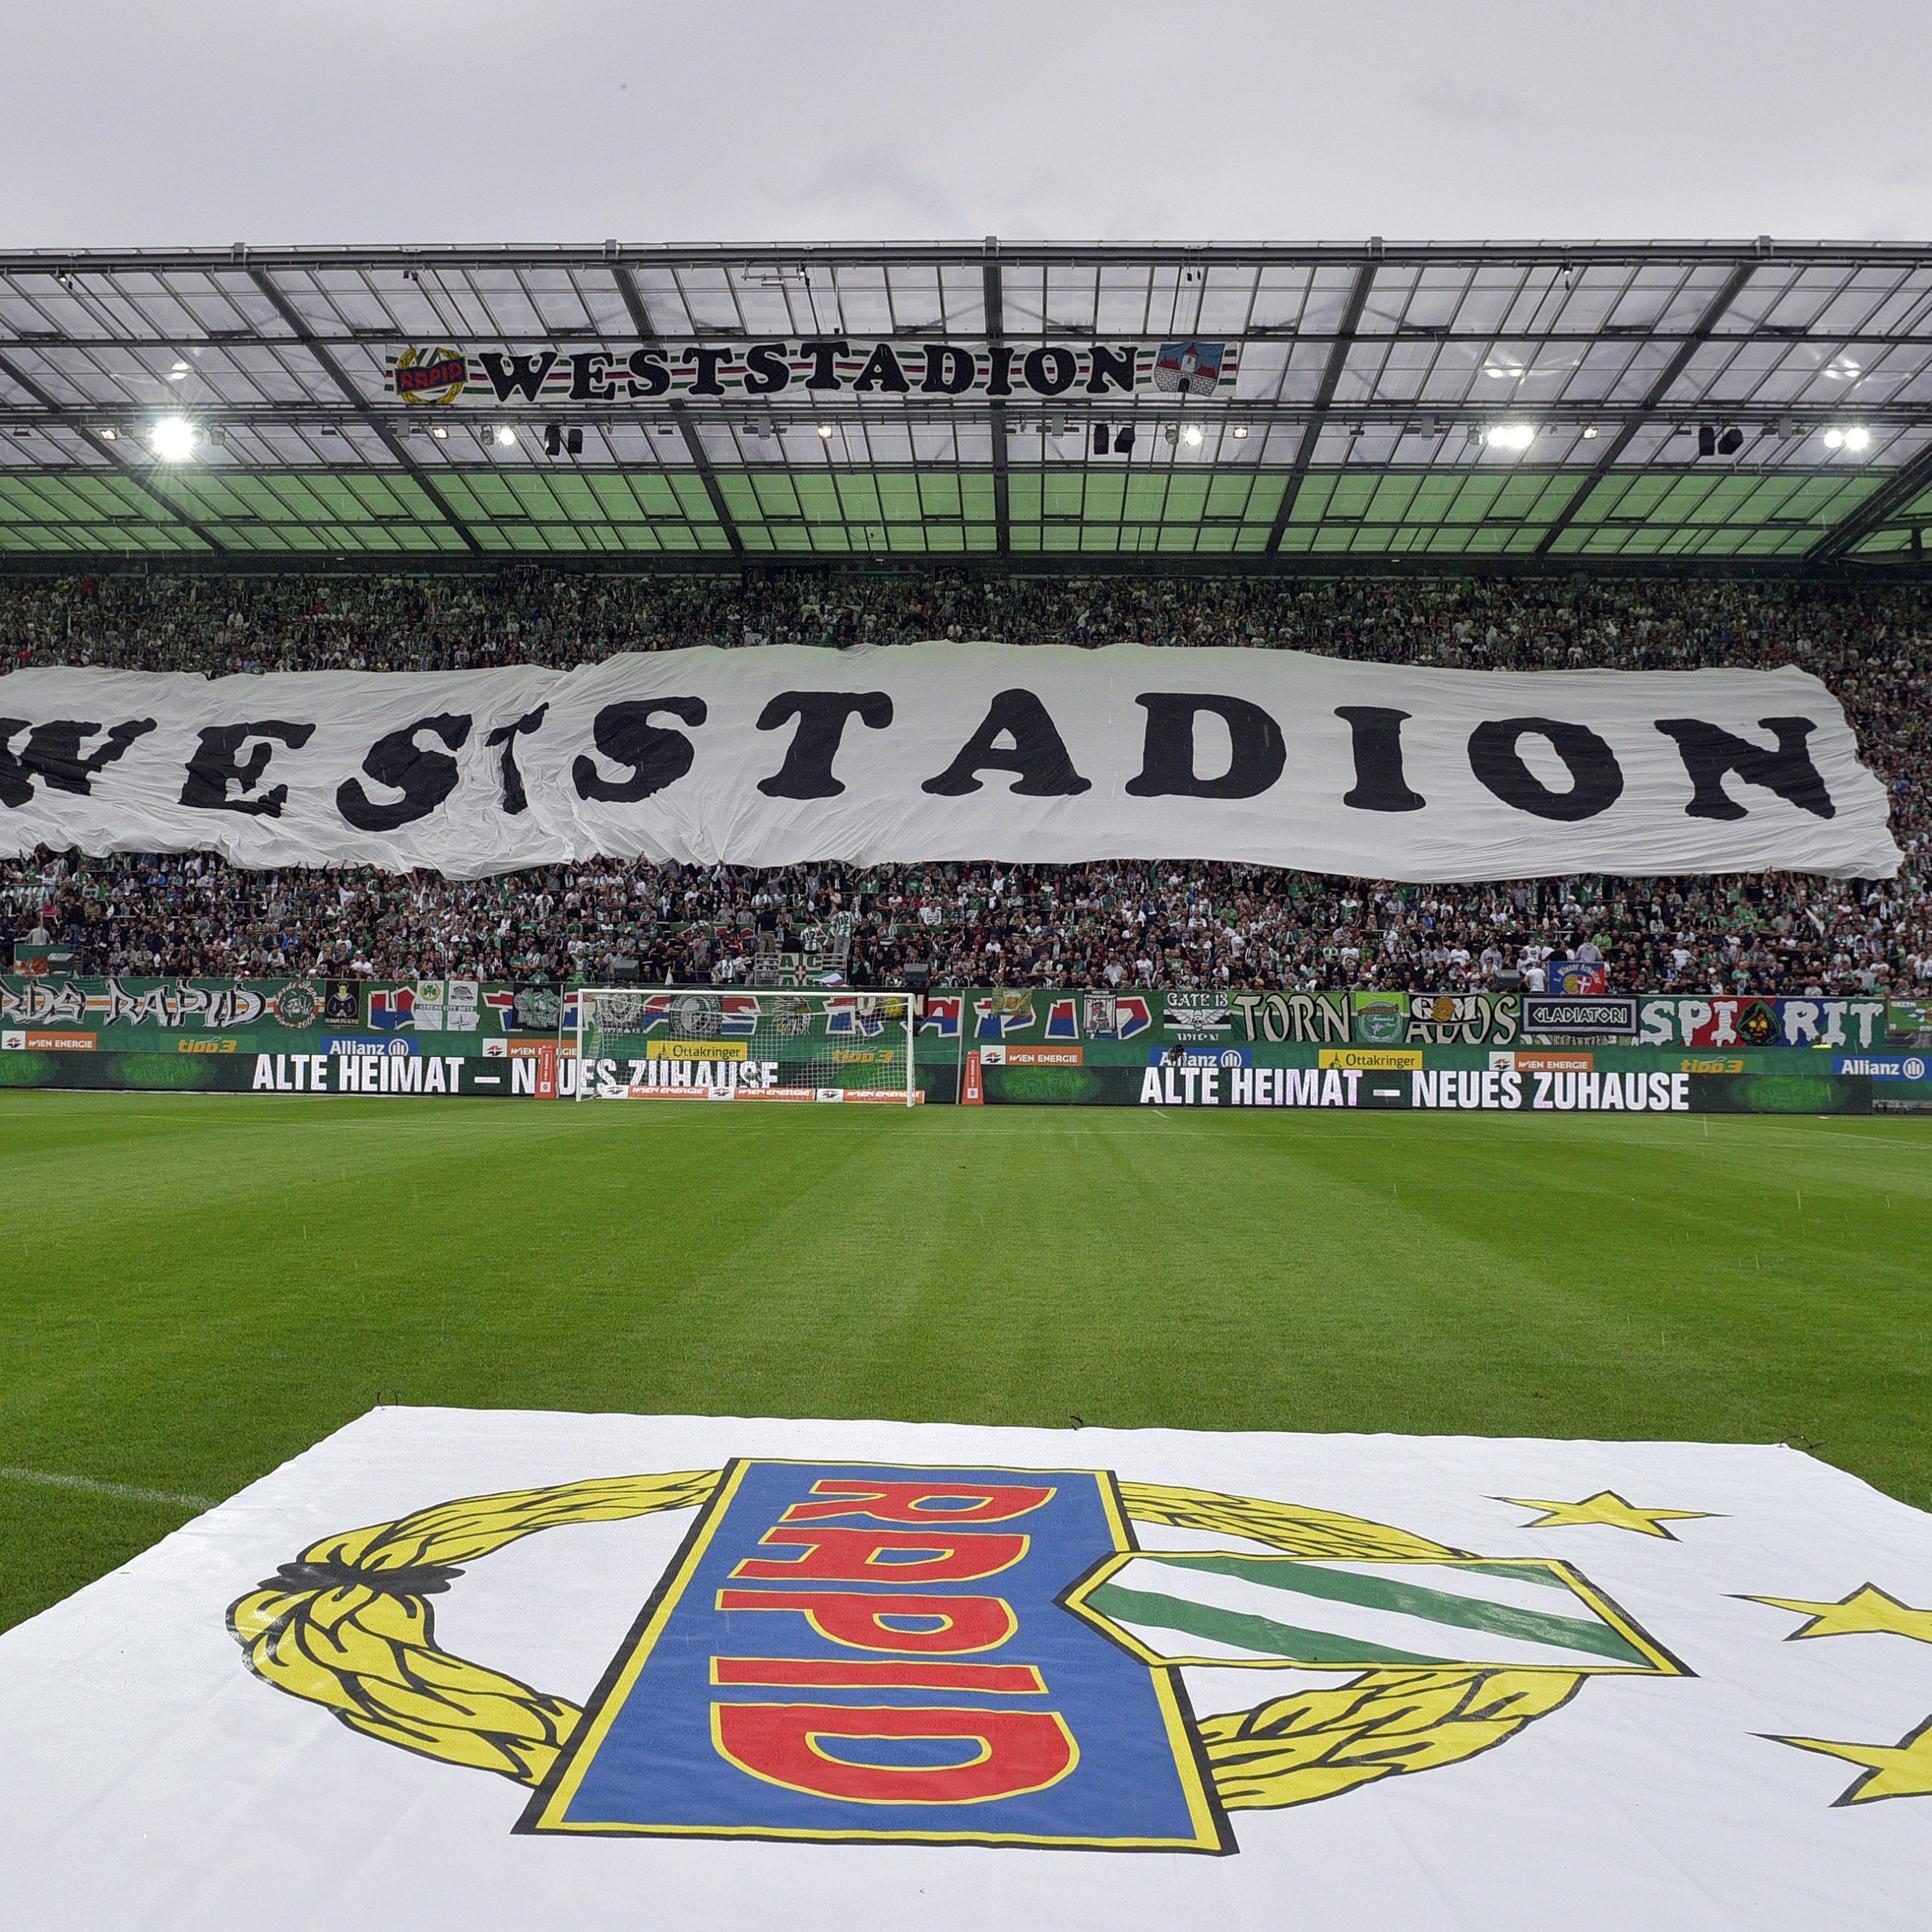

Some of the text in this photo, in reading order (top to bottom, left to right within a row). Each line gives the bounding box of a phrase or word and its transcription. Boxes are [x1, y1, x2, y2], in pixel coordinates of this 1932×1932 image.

[399, 356, 465, 389] RAPID
[478, 340, 1138, 403] WESTSTADION
[104, 976, 266, 1027] RAPID
[1167, 993, 1229, 1007] GATE 13
[1533, 1007, 1628, 1024] GLADIATORI
[28, 1040, 93, 1050] WIEN ENERGIE
[329, 1040, 385, 1056] Allianz
[510, 1047, 535, 1056] WIEN
[672, 1044, 741, 1059] Ottakringer
[1009, 1053, 1078, 1064] WIEN ENERGIE
[1345, 1053, 1416, 1070] Ottakringer
[1519, 1060, 1588, 1070] WIEN ENERGIE
[252, 1054, 328, 1091] ALTE
[339, 1055, 465, 1094] HEIMAT
[512, 1057, 616, 1095] NUES
[1841, 1060, 1900, 1075] Allianz
[767, 1088, 811, 1097] ENERGIE
[1140, 1067, 1219, 1104] ALTE
[1232, 1068, 1363, 1106] HEIMAT
[1412, 1070, 1522, 1108] NEUES
[1533, 1072, 1689, 1110] ZUHAUSE
